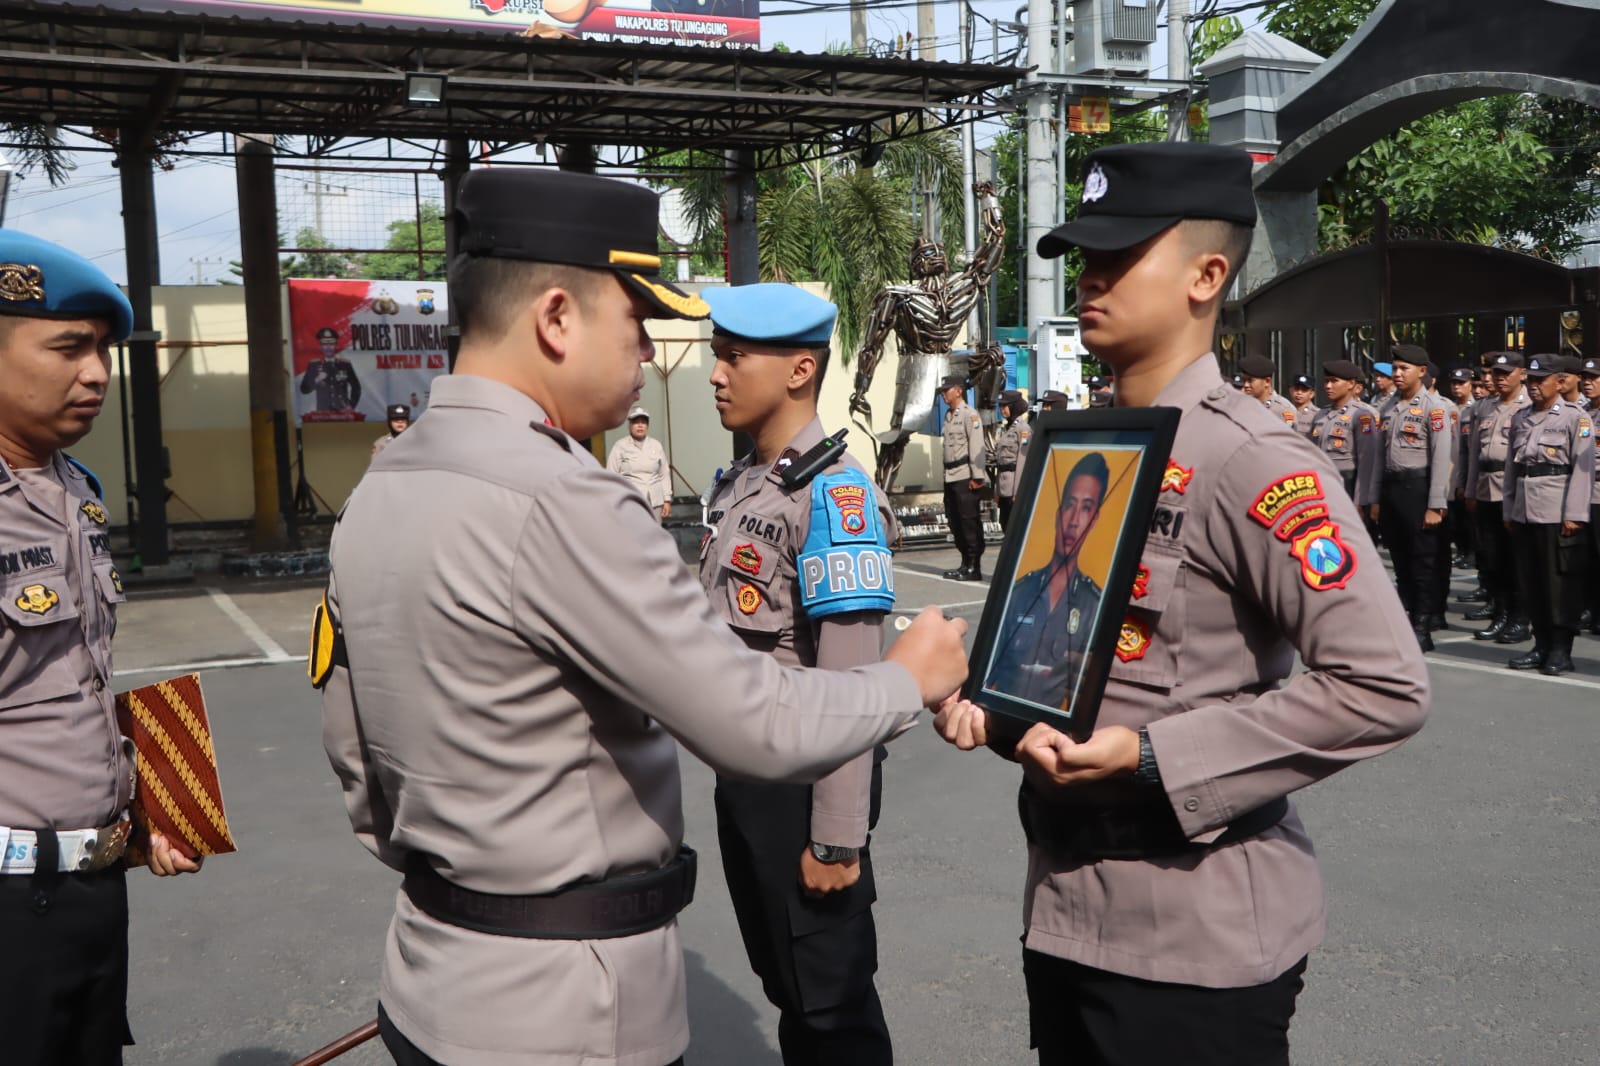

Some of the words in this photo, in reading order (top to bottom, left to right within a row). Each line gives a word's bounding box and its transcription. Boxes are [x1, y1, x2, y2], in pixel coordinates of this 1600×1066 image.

[615, 15, 669, 31] WAKAPOLRES
[670, 19, 727, 36] TULUNGAGUNG
[352, 323, 392, 351] POLRES
[1256, 475, 1315, 516] POLRES
[739, 514, 783, 543] POLRI
